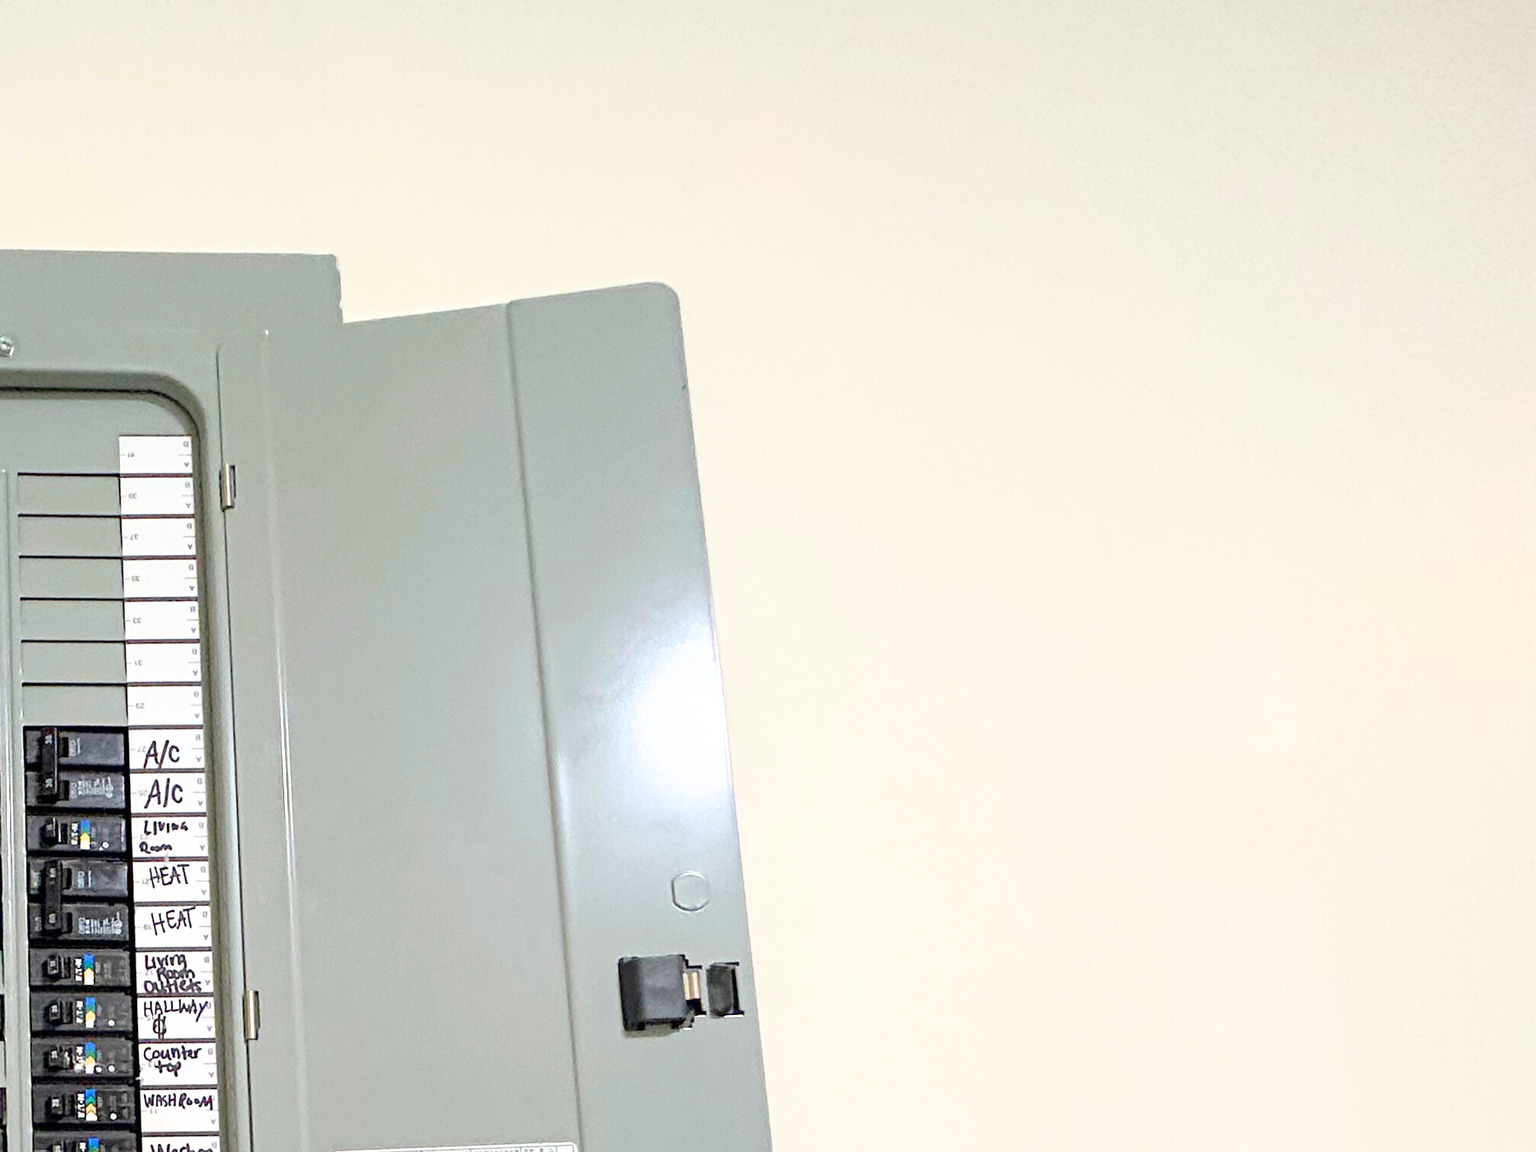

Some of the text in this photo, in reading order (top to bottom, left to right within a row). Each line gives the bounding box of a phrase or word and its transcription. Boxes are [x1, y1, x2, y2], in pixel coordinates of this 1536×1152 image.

[143, 740, 180, 769] A/C
[144, 778, 183, 809] A/C
[149, 864, 190, 888] HEAT
[151, 907, 196, 935] HEAT
